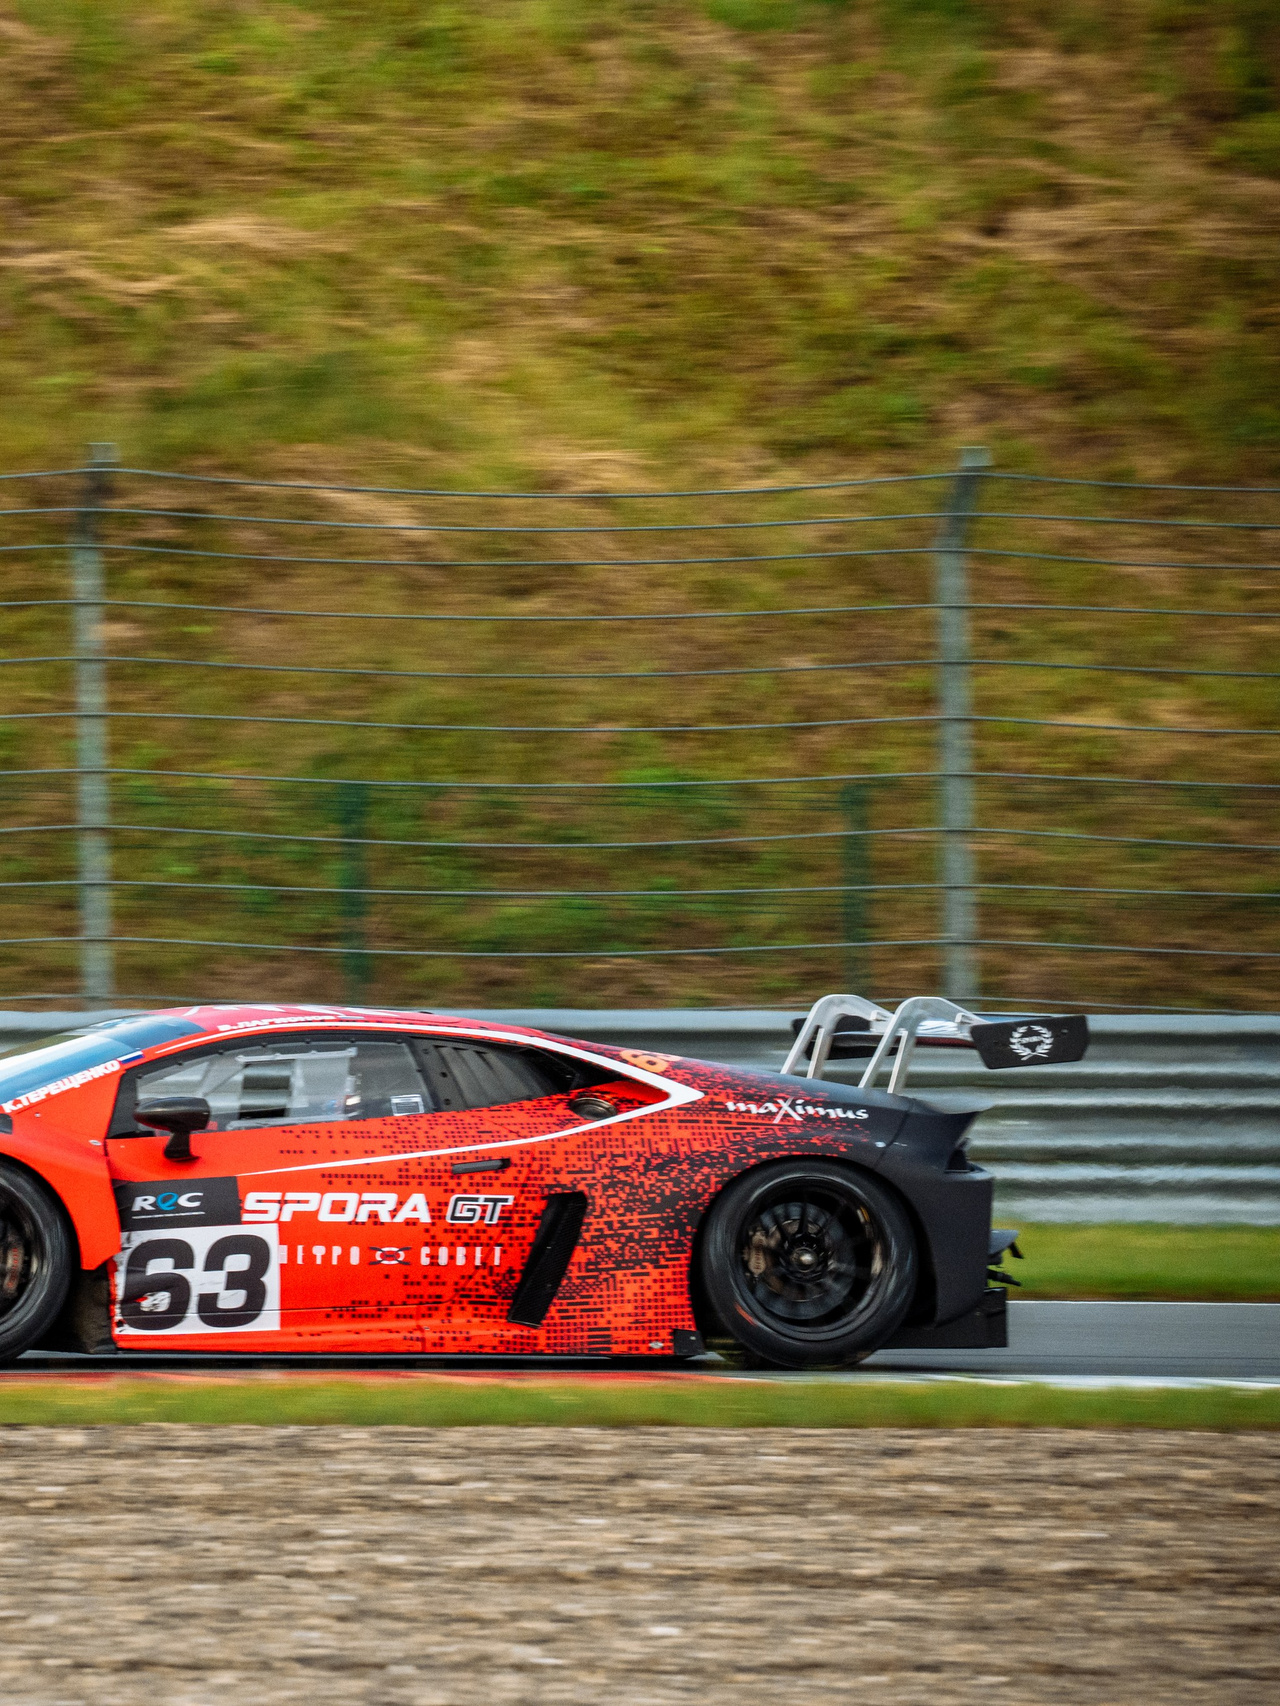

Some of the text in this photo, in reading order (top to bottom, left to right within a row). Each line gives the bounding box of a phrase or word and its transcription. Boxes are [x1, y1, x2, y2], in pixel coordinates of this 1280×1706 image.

[241, 1192, 514, 1224] SPORA GT
[120, 1234, 270, 1331] 63
